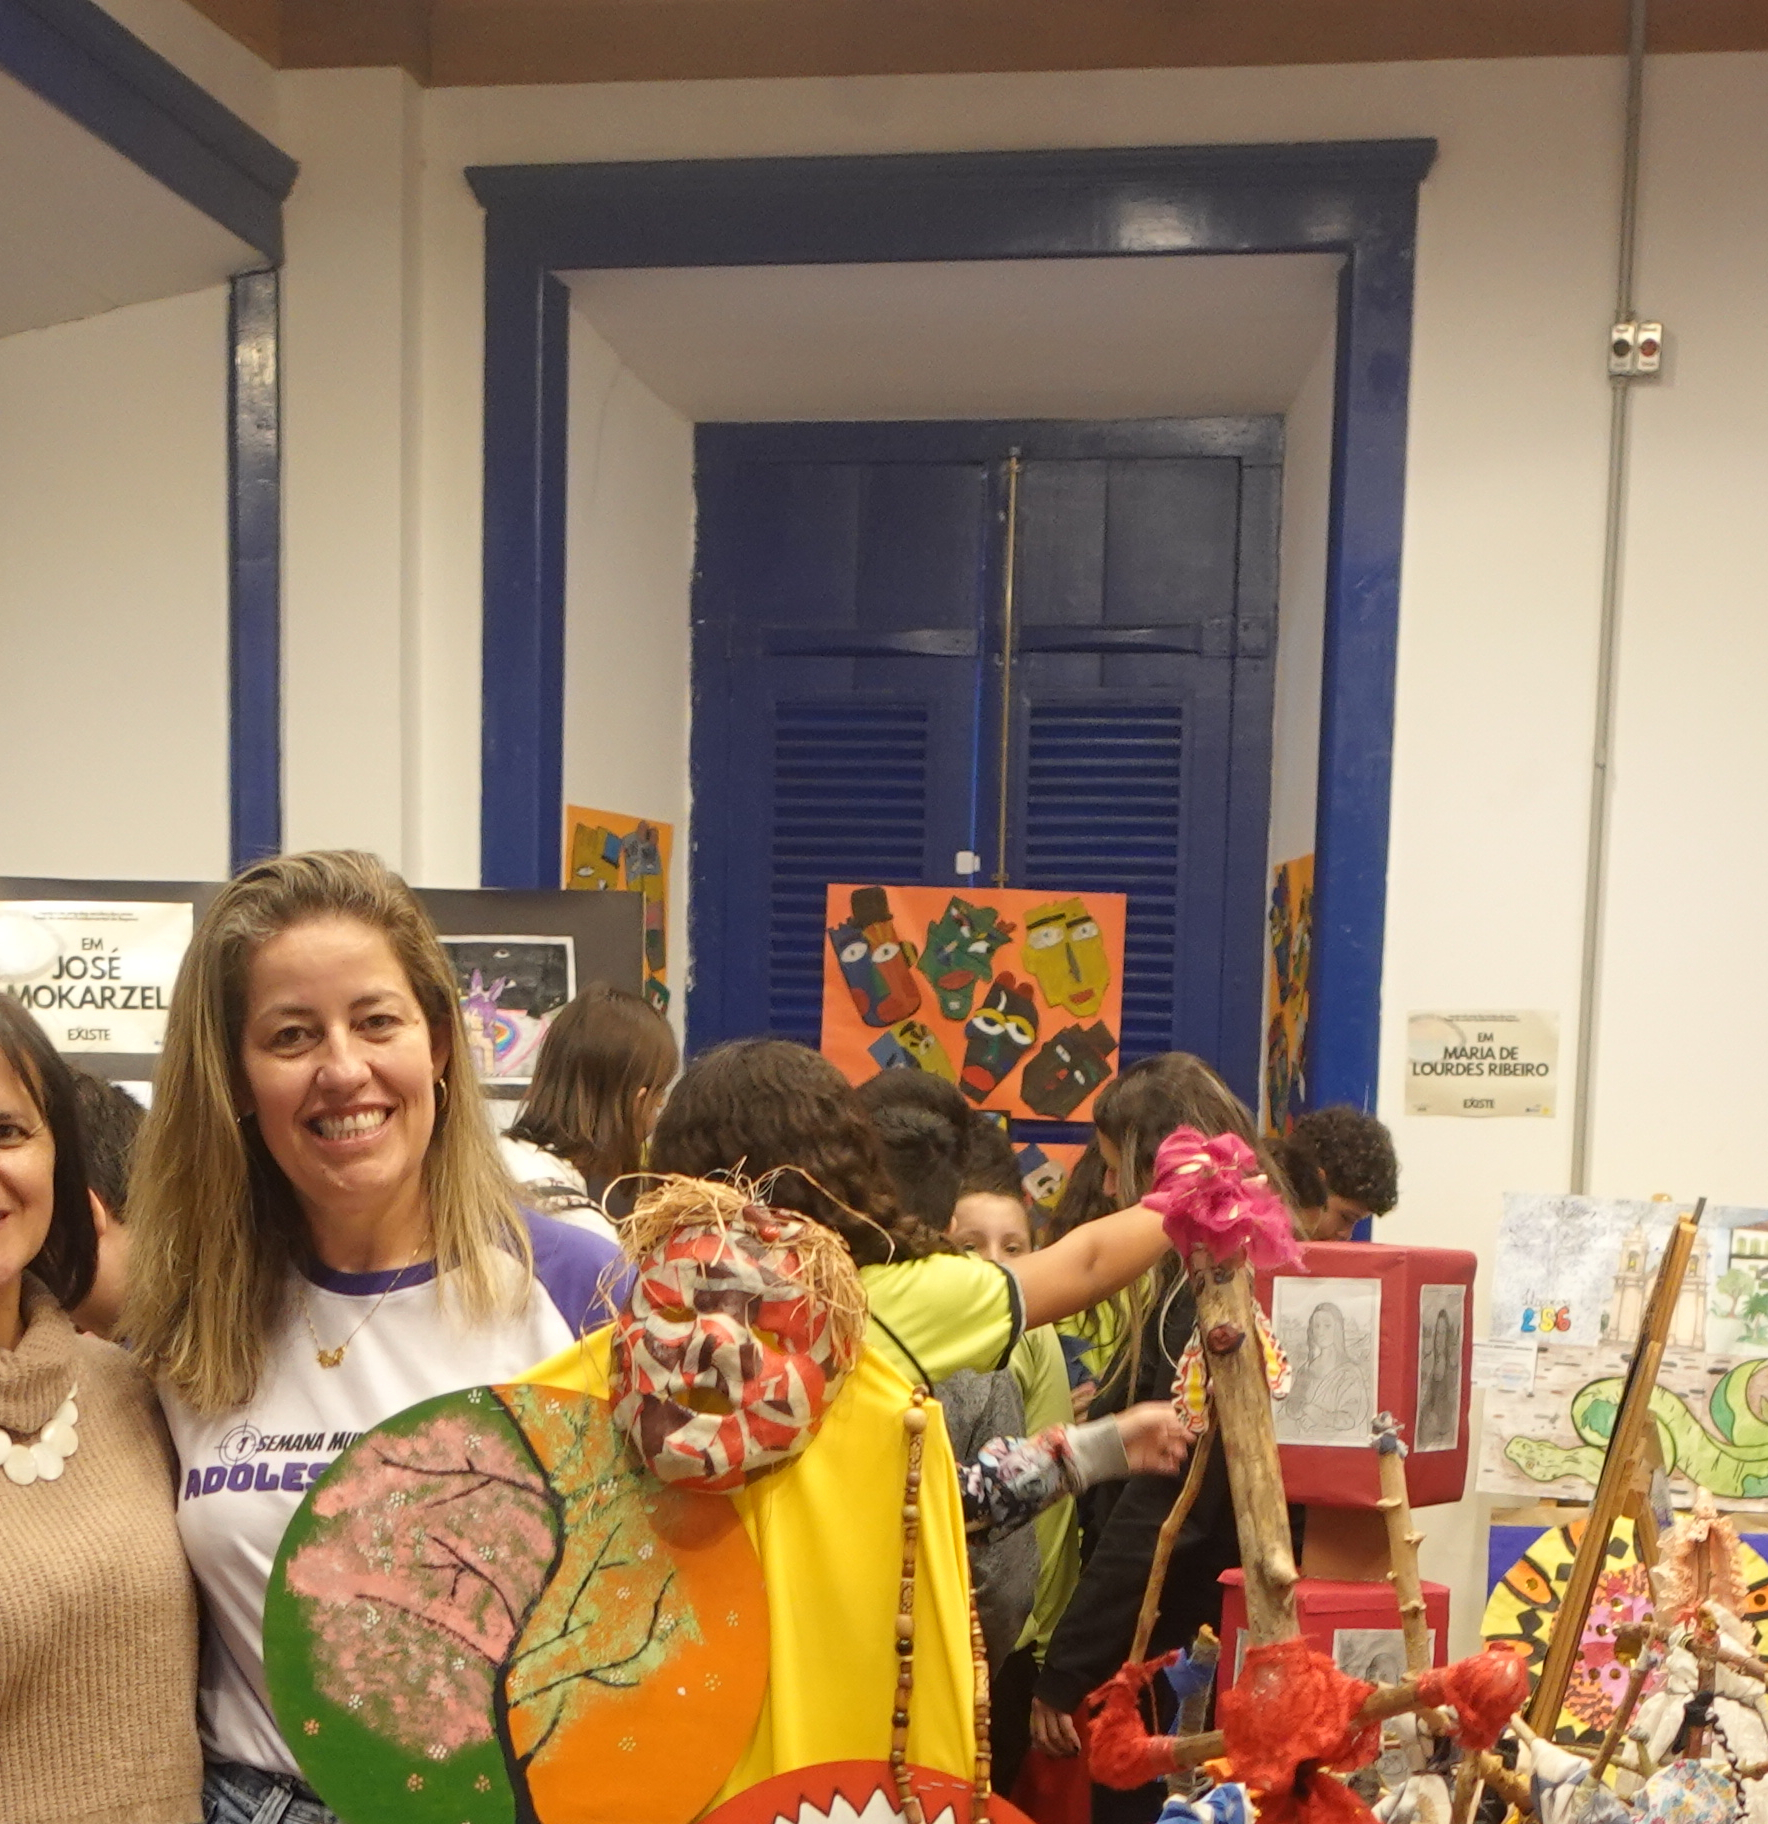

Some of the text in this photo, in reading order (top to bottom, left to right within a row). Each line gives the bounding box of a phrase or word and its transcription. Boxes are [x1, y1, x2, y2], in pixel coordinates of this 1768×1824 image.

[82, 938, 104, 951] EM
[52, 948, 122, 980] JOSÉ
[7, 985, 171, 1010] MOKARZEL
[67, 1028, 112, 1041] EXISTE
[1477, 1032, 1494, 1043] EM
[1443, 1046, 1519, 1060] MARIA DE
[1412, 1062, 1550, 1077] LOURDES RIBEIRO
[1463, 1098, 1496, 1109] EXISTE
[256, 1431, 327, 1452] SEMANA
